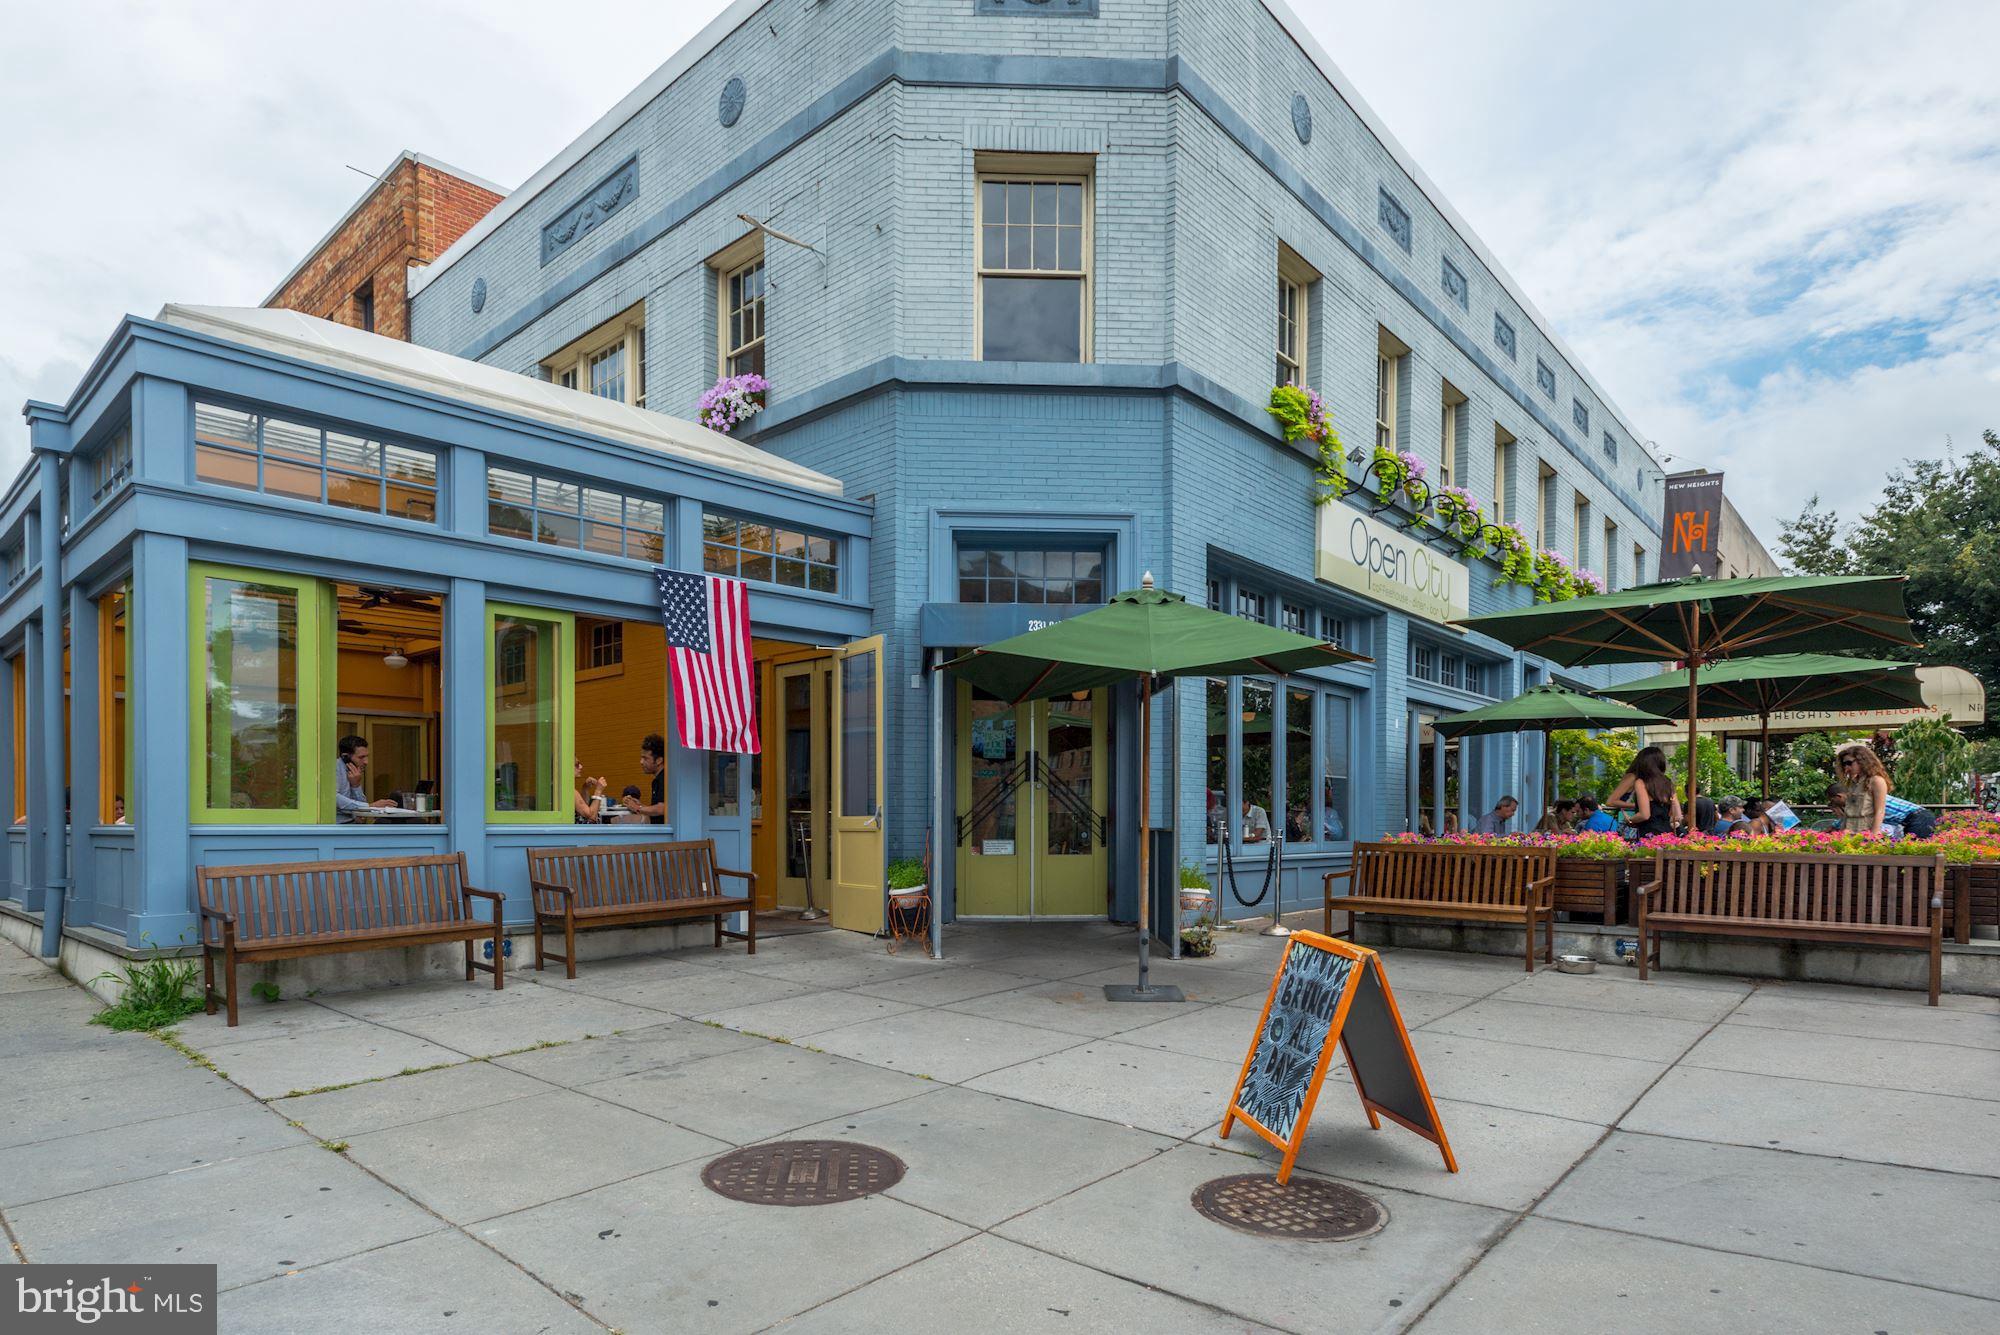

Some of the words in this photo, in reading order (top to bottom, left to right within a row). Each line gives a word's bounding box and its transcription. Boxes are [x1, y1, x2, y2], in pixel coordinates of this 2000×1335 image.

[1687, 480, 1720, 489] HEIGHTS
[1350, 517, 1407, 590] Open
[1413, 548, 1450, 620] City
[1774, 711, 1831, 720] HEIGHTS
[1279, 974, 1341, 1023] BRUNCH
[1264, 1044, 1296, 1087] DAY
